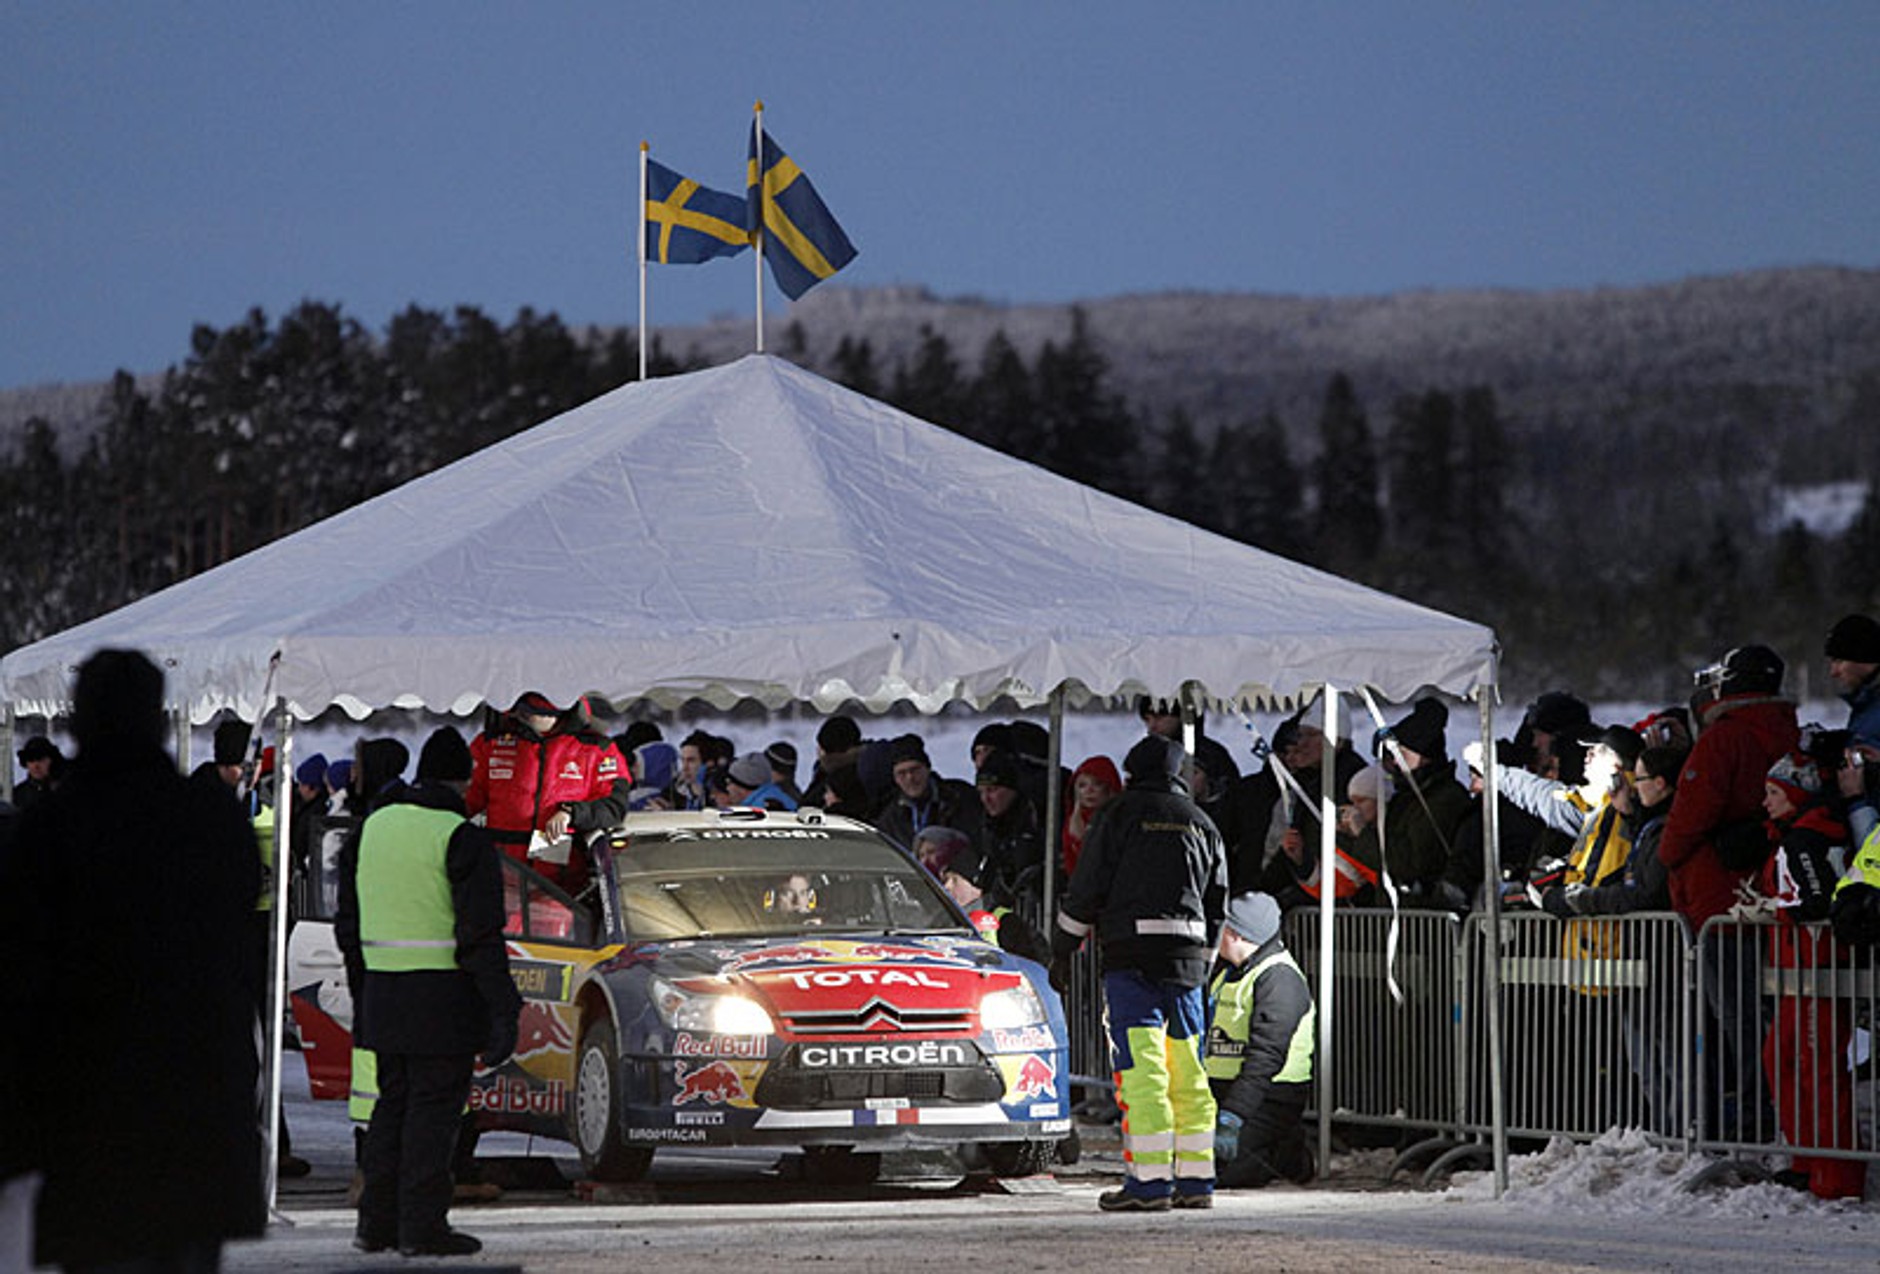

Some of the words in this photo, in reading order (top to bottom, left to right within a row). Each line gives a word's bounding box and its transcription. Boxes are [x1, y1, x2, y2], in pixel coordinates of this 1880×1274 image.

[778, 970, 949, 989] TOTAL
[672, 1032, 716, 1056] Red
[718, 1034, 768, 1058] Bull
[467, 1075, 506, 1111] ed
[508, 1078, 565, 1114] Bull
